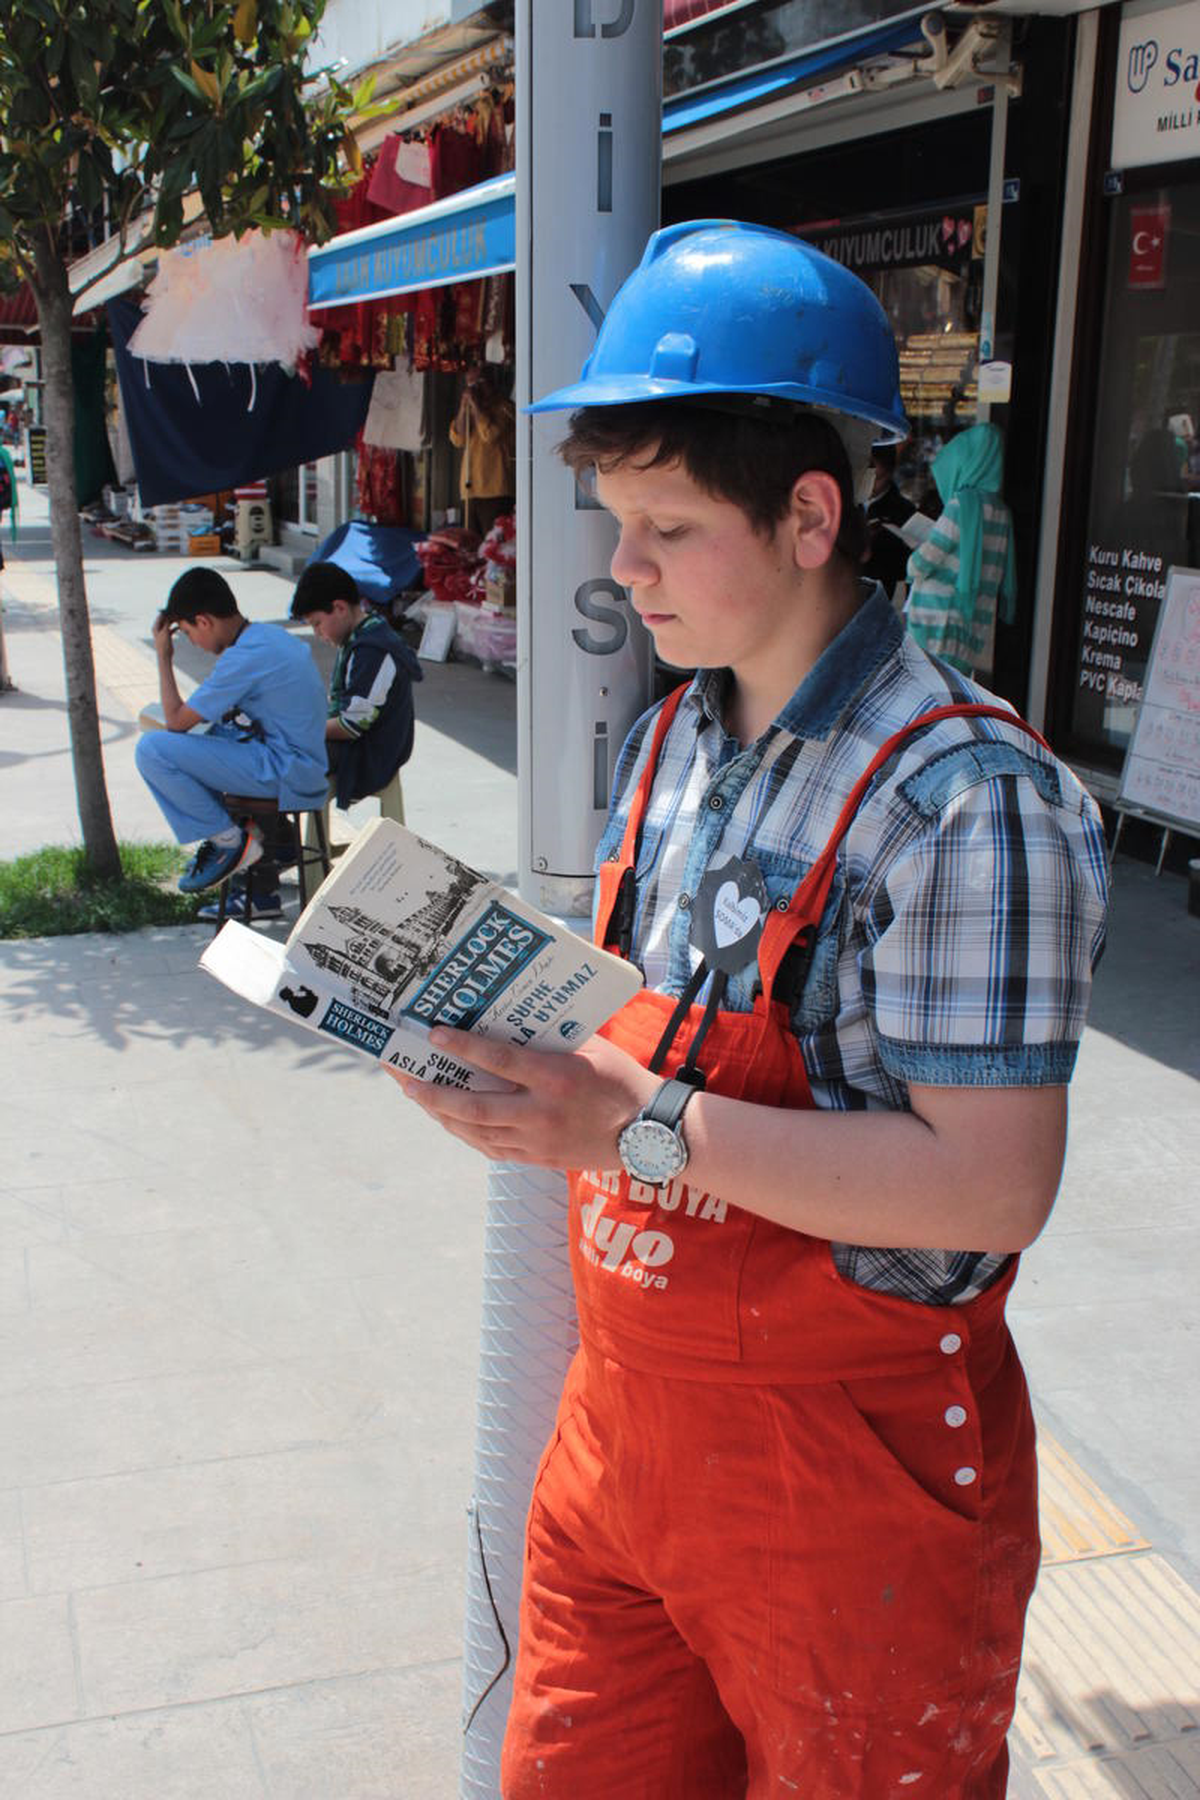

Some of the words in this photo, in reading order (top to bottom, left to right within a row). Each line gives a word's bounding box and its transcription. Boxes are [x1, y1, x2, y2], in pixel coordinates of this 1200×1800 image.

[1089, 545, 1119, 566] Kuru
[1122, 549, 1162, 572] Kahve
[1085, 596, 1136, 621] Nescafe
[1083, 621, 1138, 647] Kapiçino
[1081, 645, 1122, 669] Krema
[1079, 671, 1106, 692] PVC
[413, 911, 511, 1018] SHERLOCK
[433, 925, 534, 1026] HOLMES
[510, 1025, 537, 1047] LA
[533, 963, 599, 1024] UYUMAZ
[326, 1012, 385, 1050] HOLMES
[332, 1002, 390, 1039] SHERLOCK
[388, 1051, 425, 1078] ASLA
[620, 1260, 669, 1289] boya
